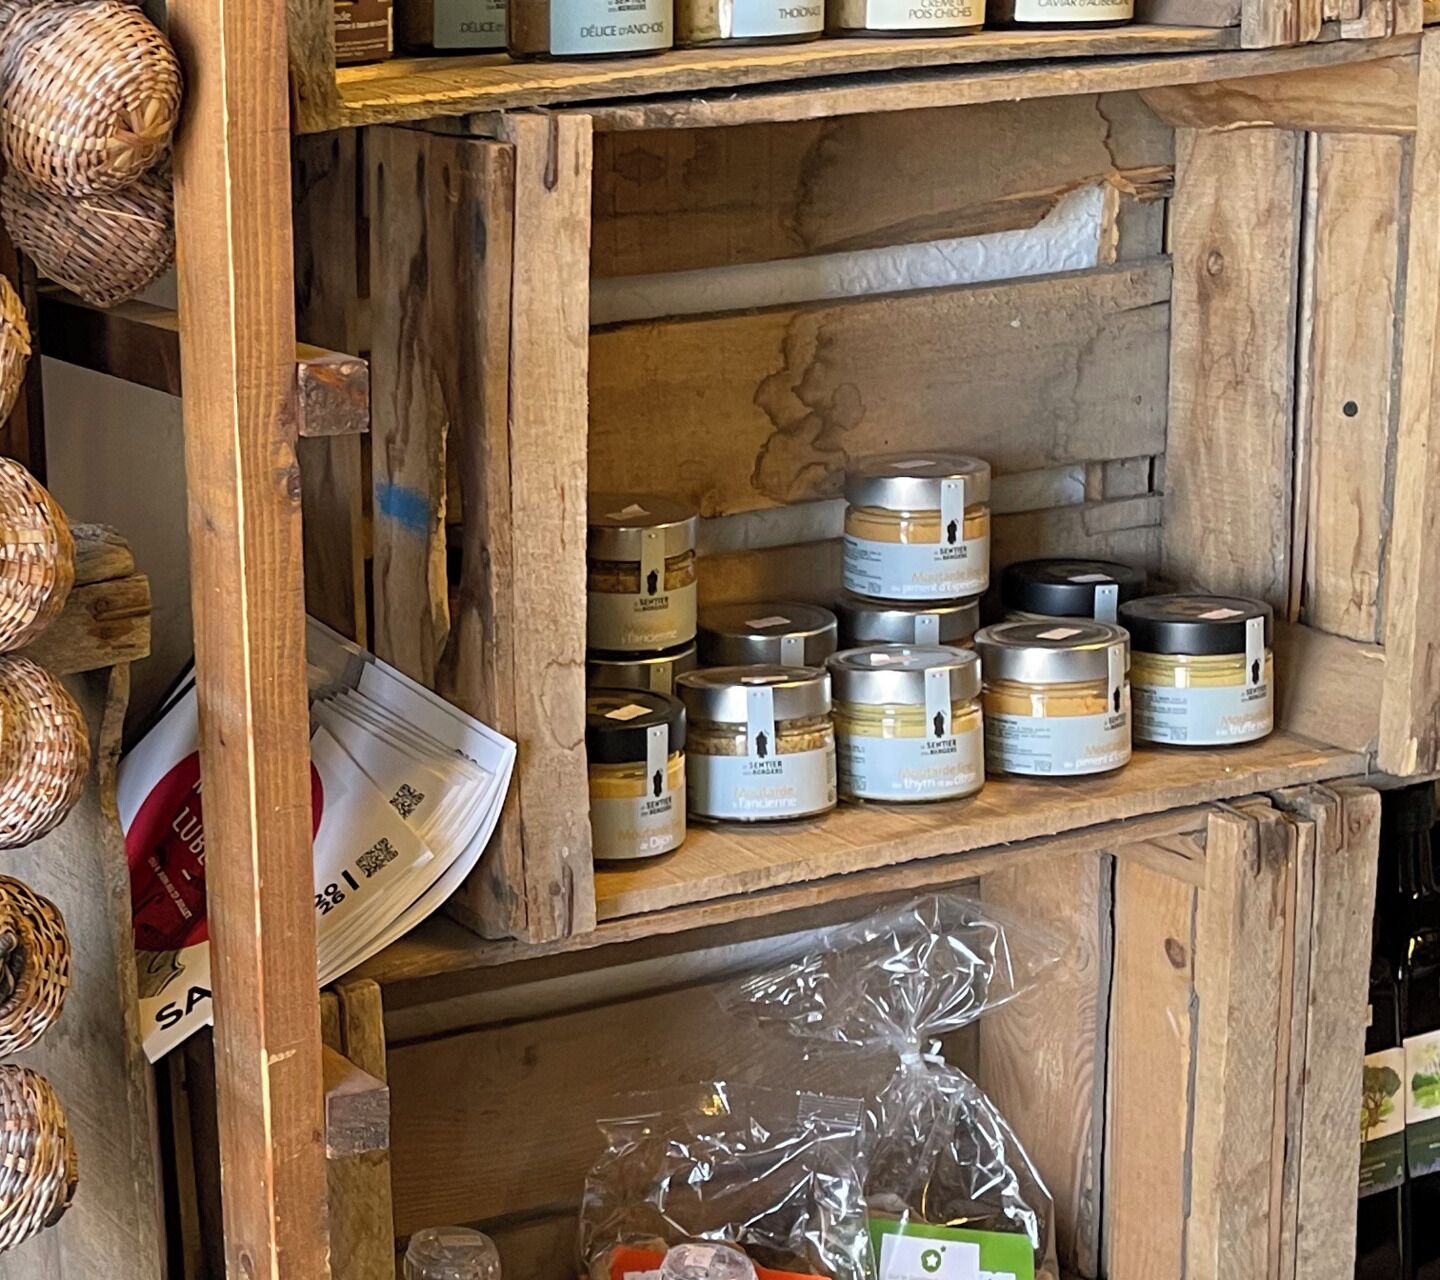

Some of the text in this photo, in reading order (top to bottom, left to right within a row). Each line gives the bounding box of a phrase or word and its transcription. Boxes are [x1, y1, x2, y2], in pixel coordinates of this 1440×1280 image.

[909, 6, 972, 19] POIS CHICHES
[580, 24, 617, 38] DÉLICE
[903, 777, 936, 792] thym
[738, 797, 797, 809] l'ancienne
[315, 883, 338, 907] 20
[320, 892, 346, 916] 26
